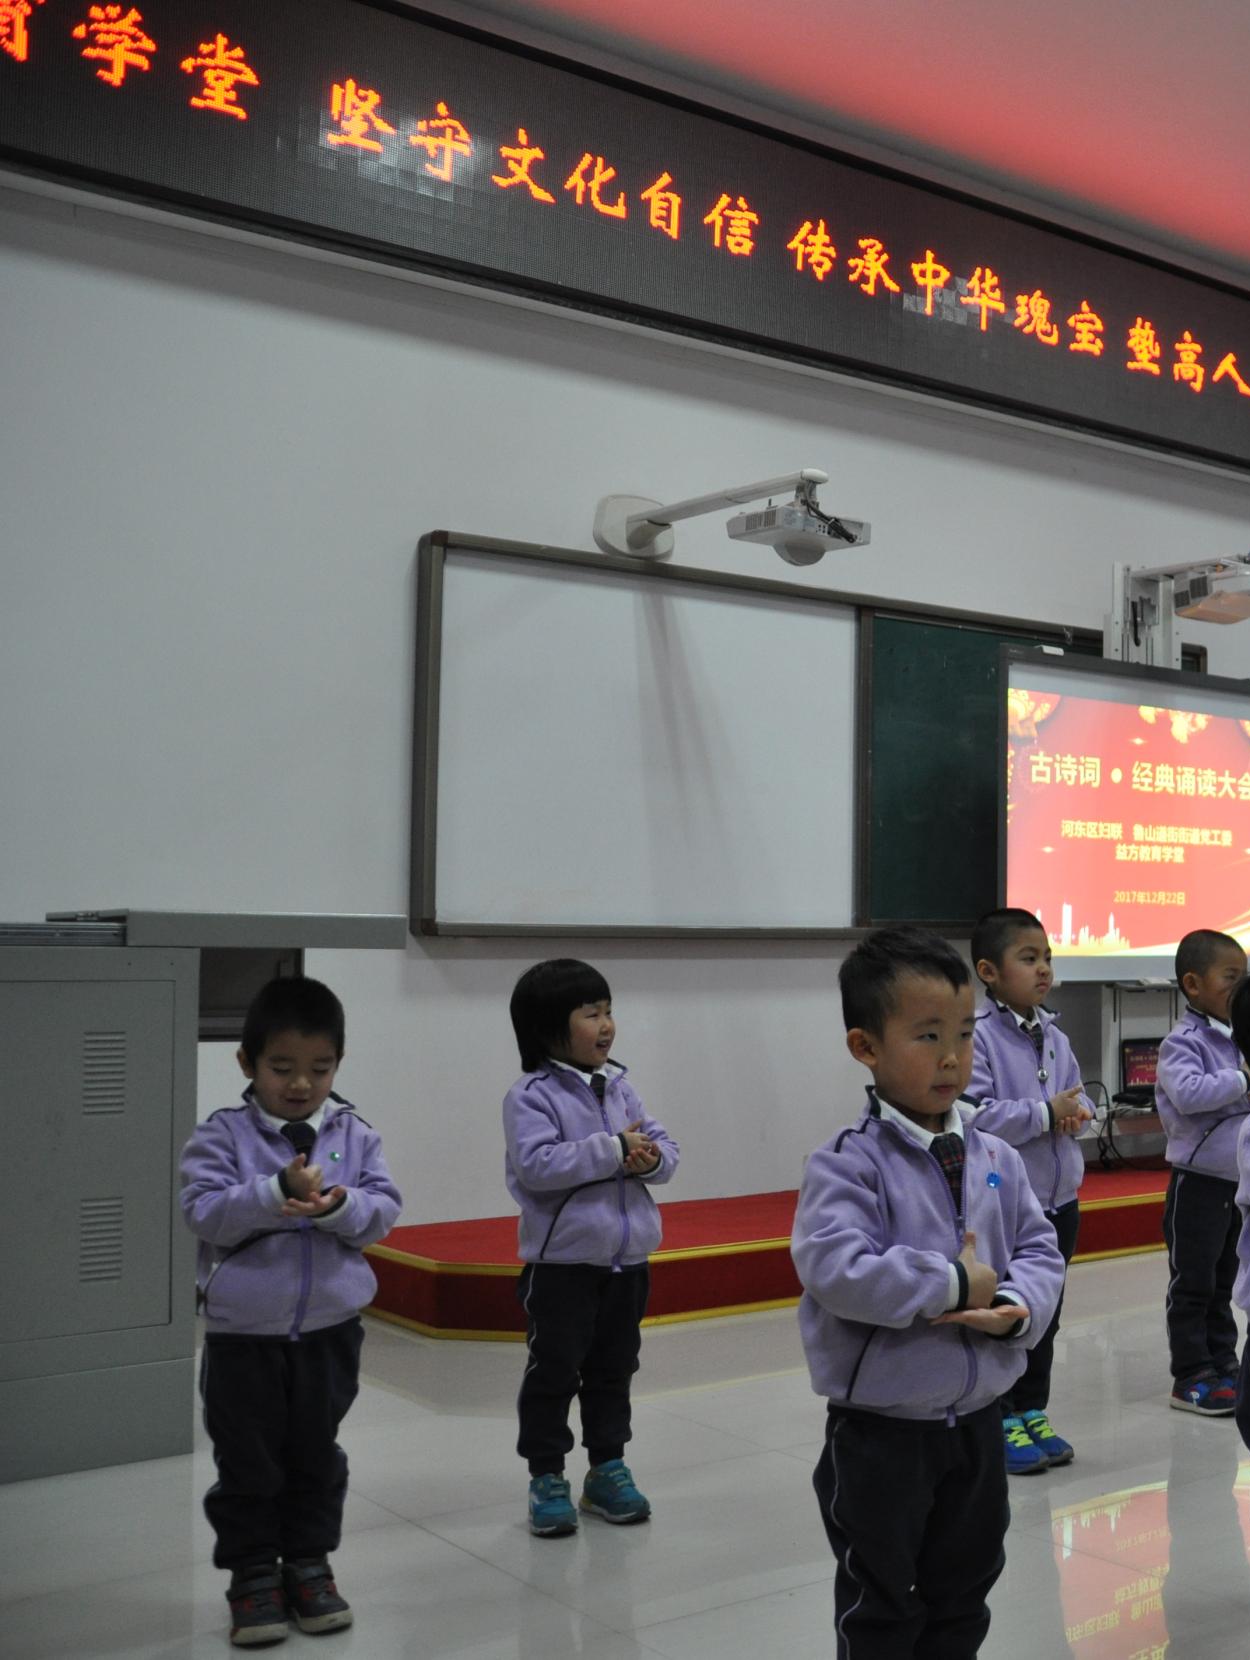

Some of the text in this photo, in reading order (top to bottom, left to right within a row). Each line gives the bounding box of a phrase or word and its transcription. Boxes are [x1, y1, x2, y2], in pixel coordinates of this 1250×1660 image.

[327, 78, 760, 256] 坚守文化自信
[786, 219, 1105, 357] 传承中华瑰宝
[1029, 751, 1101, 788] 古诗词
[1061, 820, 1123, 841] 河东区妇联
[1113, 890, 1186, 907] 2017年12月22日
